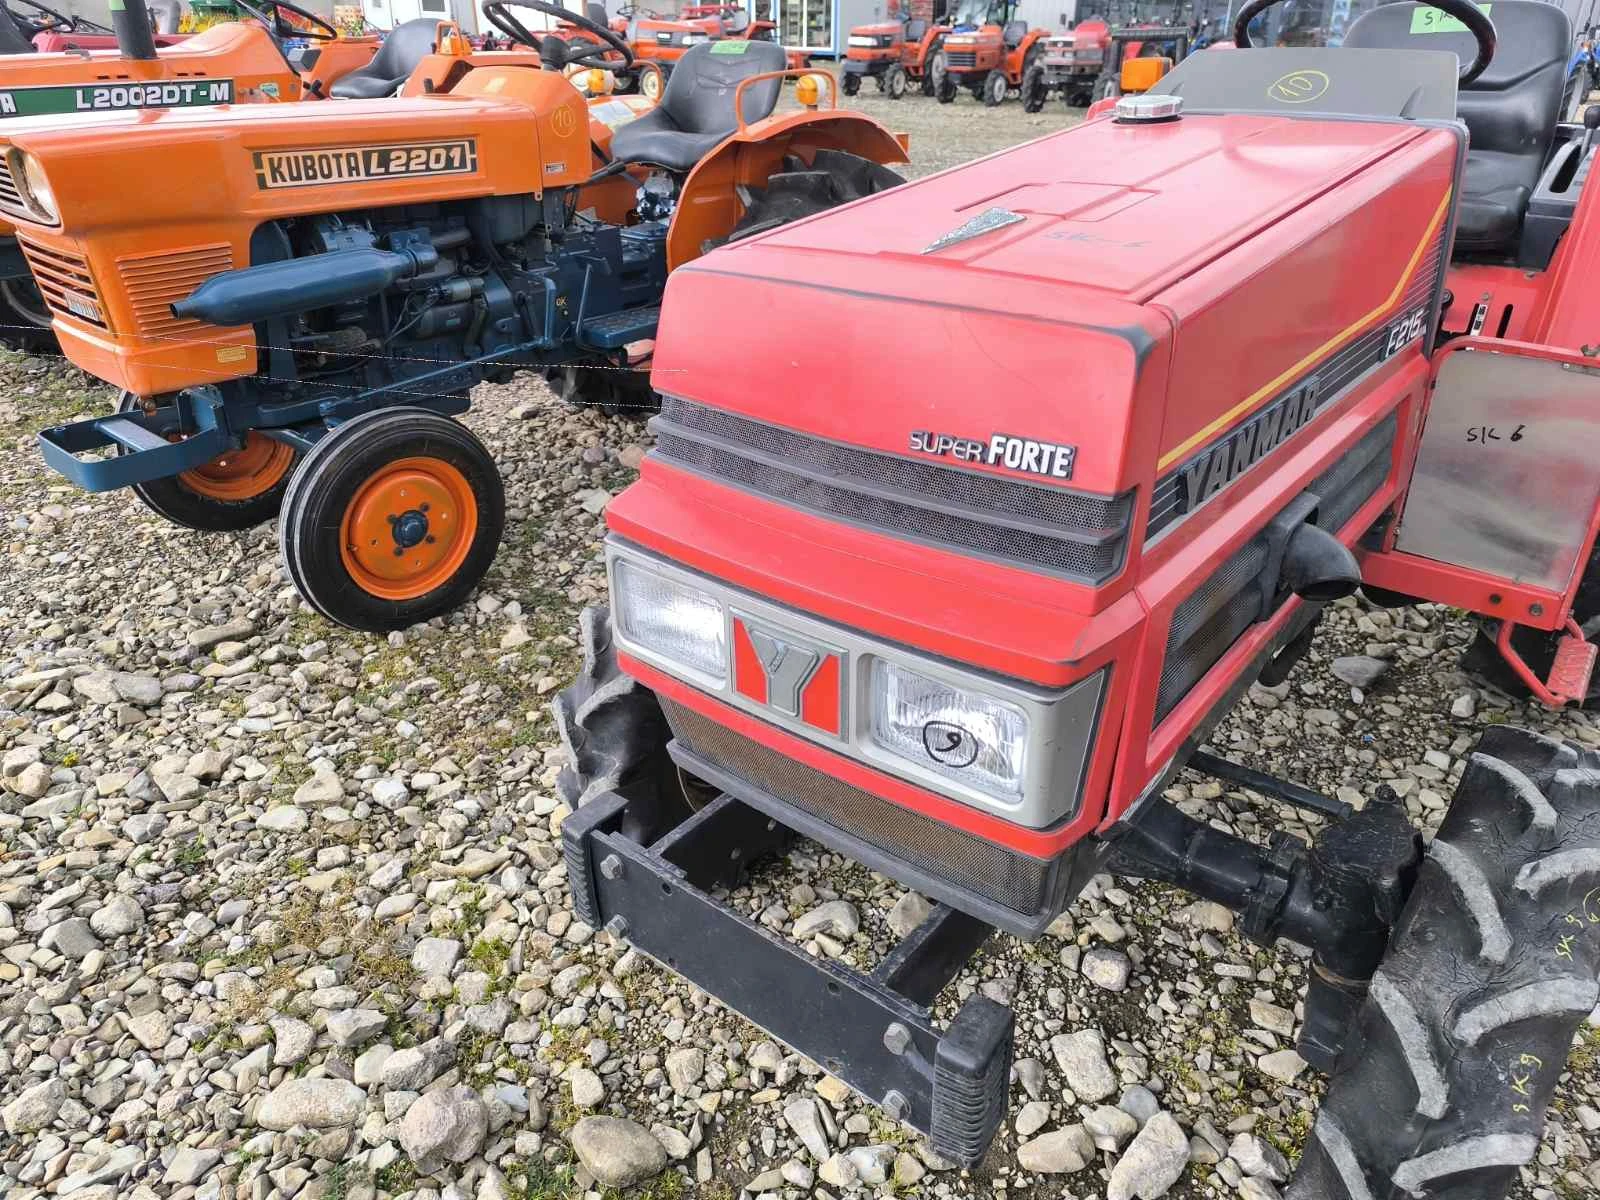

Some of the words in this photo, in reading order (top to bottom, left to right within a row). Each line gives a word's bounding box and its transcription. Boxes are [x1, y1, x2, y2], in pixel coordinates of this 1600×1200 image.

[76, 83, 230, 110] L2002DT-M
[268, 152, 361, 183] KUBOTA
[369, 147, 462, 175] L2201
[1180, 377, 1321, 514] YANMAR
[1509, 424, 1527, 443] 6
[909, 431, 984, 462] SUPER
[987, 434, 1074, 479] FORTE
